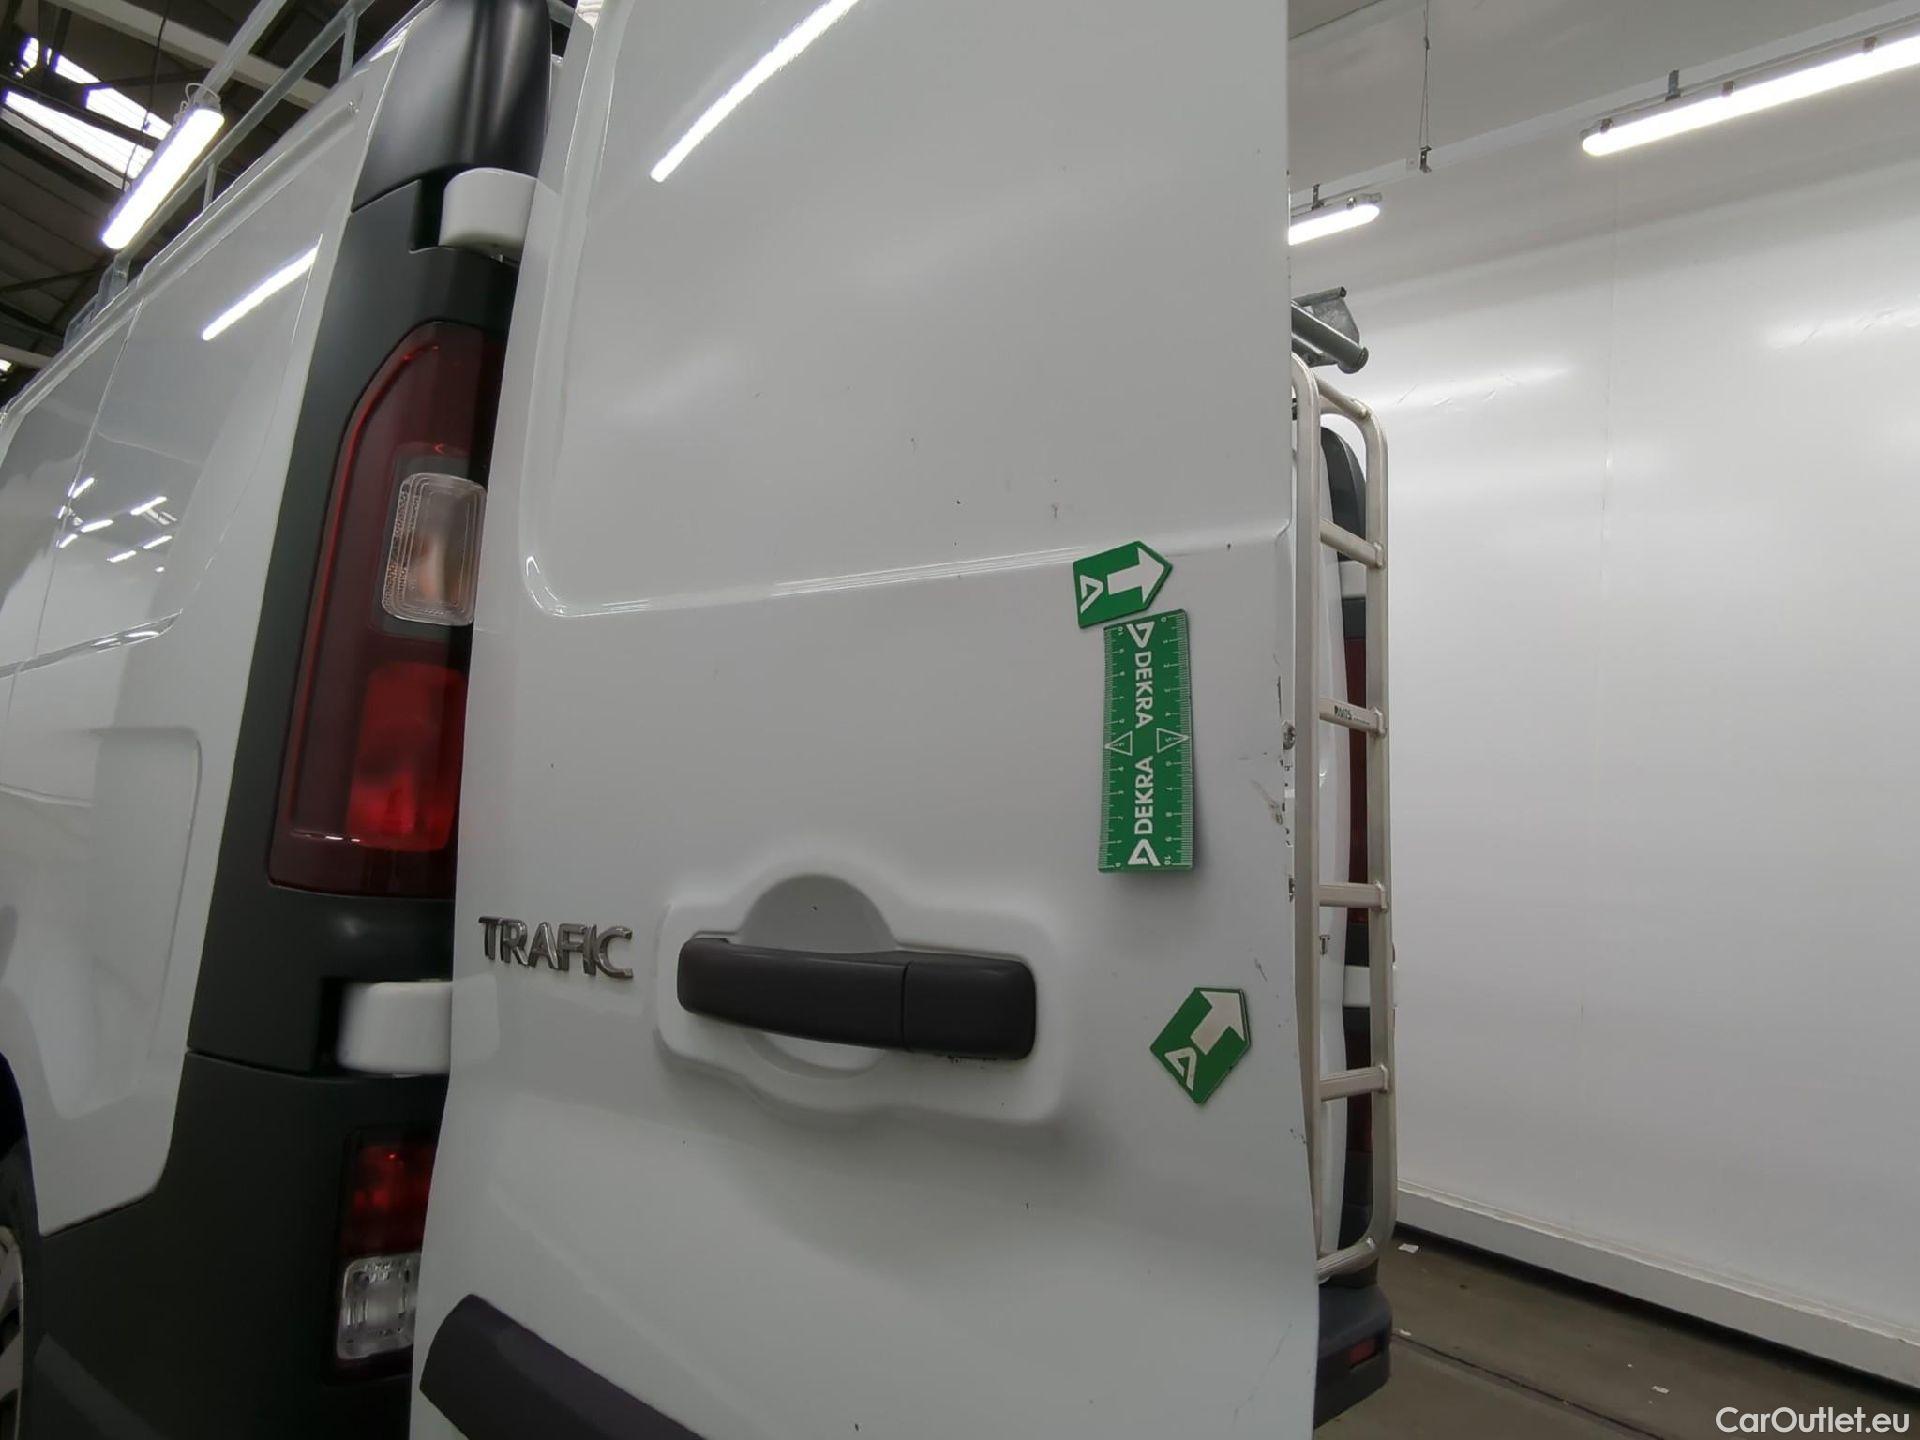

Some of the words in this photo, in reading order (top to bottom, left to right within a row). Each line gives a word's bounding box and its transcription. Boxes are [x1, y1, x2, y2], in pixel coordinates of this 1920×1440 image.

[1135, 651, 1154, 728] DEKRA
[1134, 755, 1154, 835] DEKRA
[478, 915, 634, 979] TRAFIC
